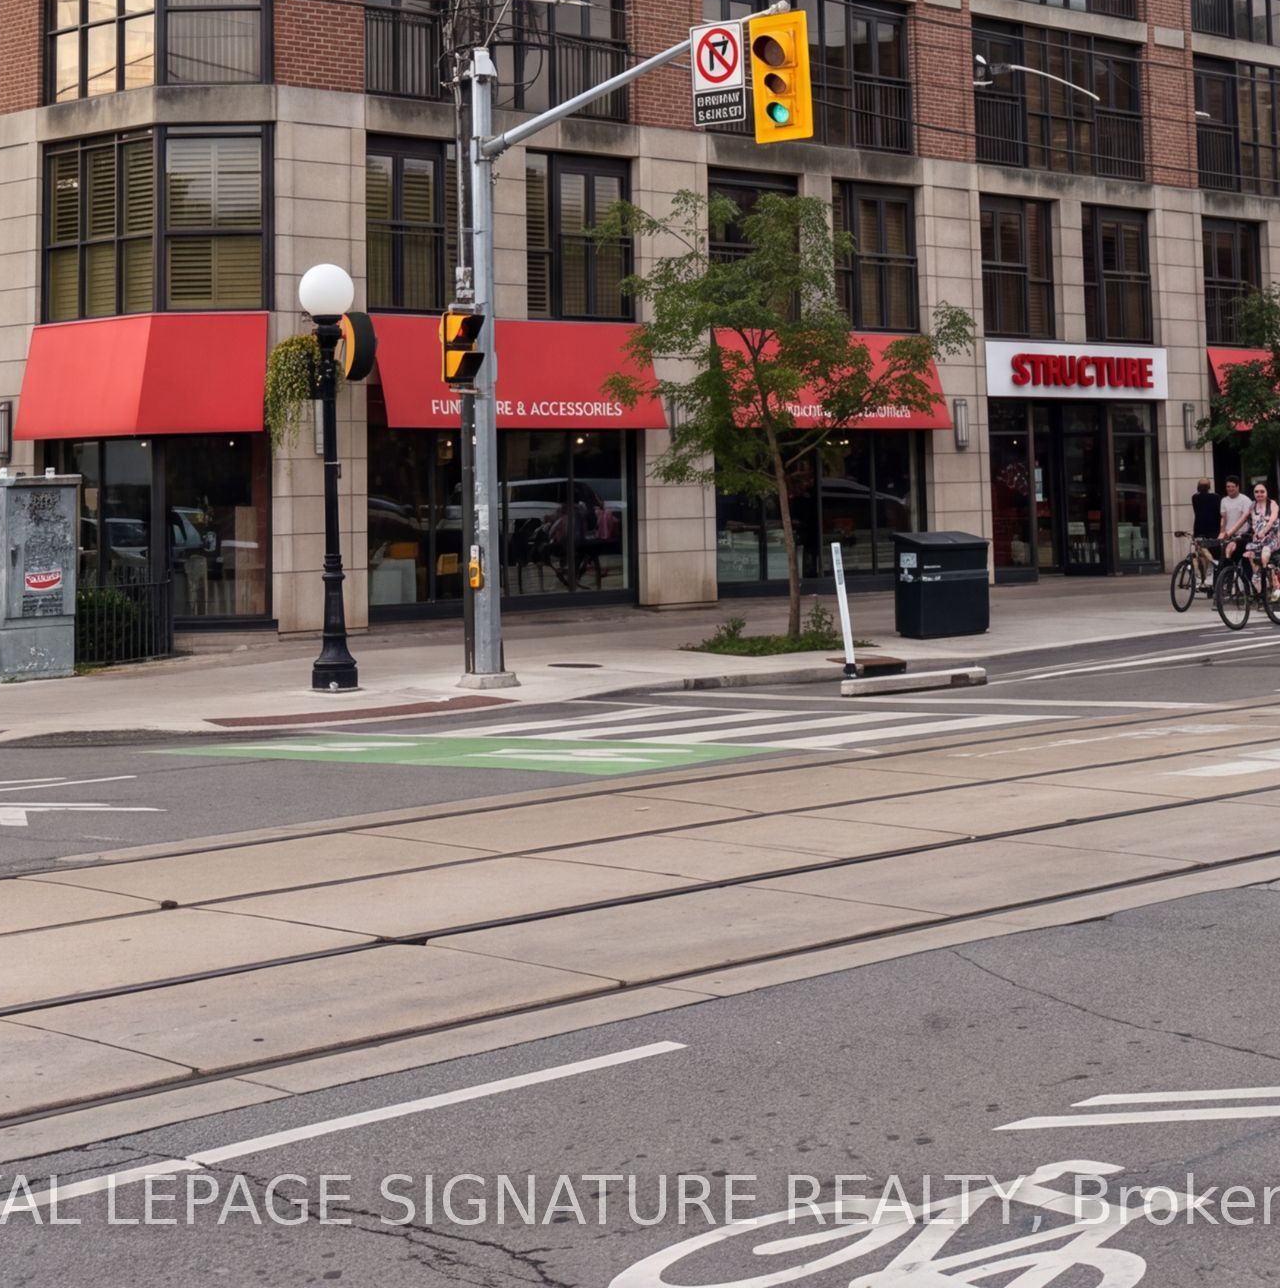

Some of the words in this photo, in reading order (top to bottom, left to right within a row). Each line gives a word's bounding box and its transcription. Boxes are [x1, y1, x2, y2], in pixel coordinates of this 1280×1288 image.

[1011, 353, 1154, 388] STRUCTURE
[517, 401, 527, 416] &
[530, 401, 622, 417] ACCESSORIES
